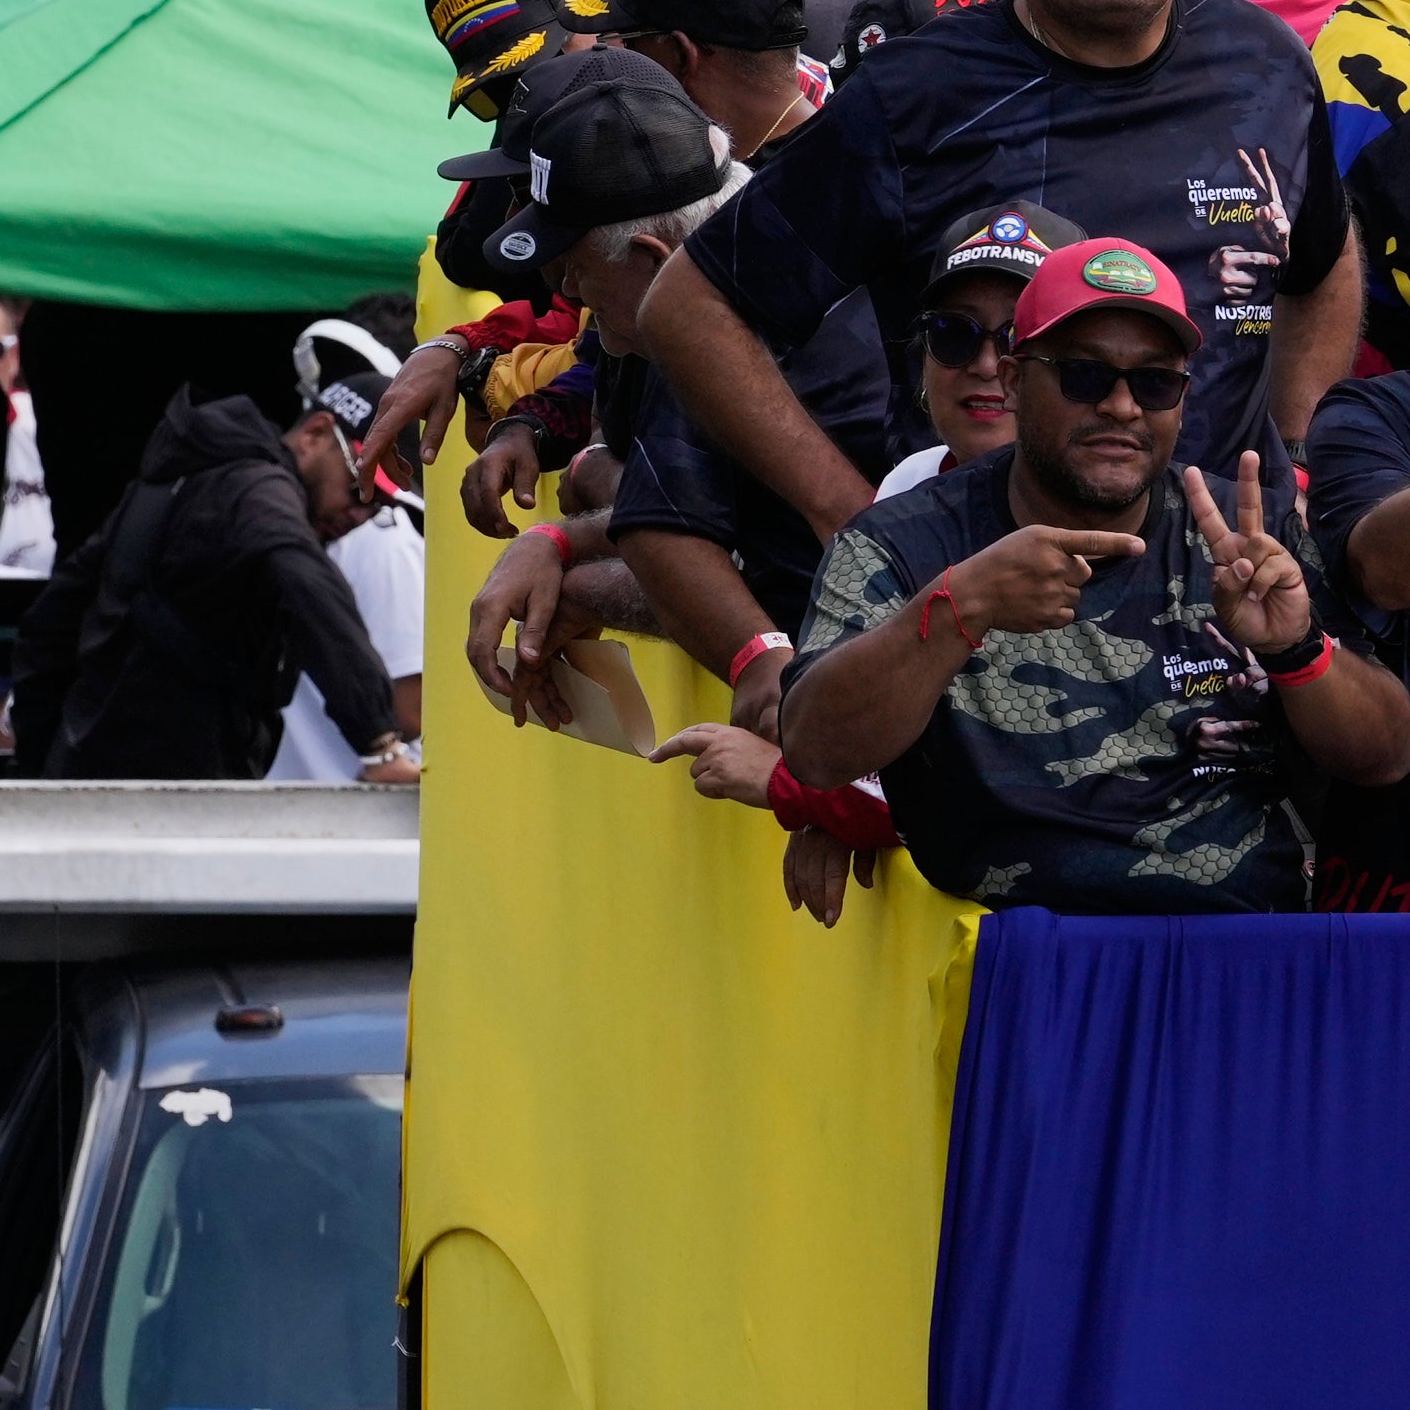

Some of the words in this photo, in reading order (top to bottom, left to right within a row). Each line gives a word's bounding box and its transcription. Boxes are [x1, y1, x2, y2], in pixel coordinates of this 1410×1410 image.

[1187, 178, 1206, 189] Los
[1188, 187, 1258, 206] queremos
[1209, 201, 1255, 225] Vuelta
[1163, 653, 1182, 666] Los
[1163, 657, 1229, 681] queemos
